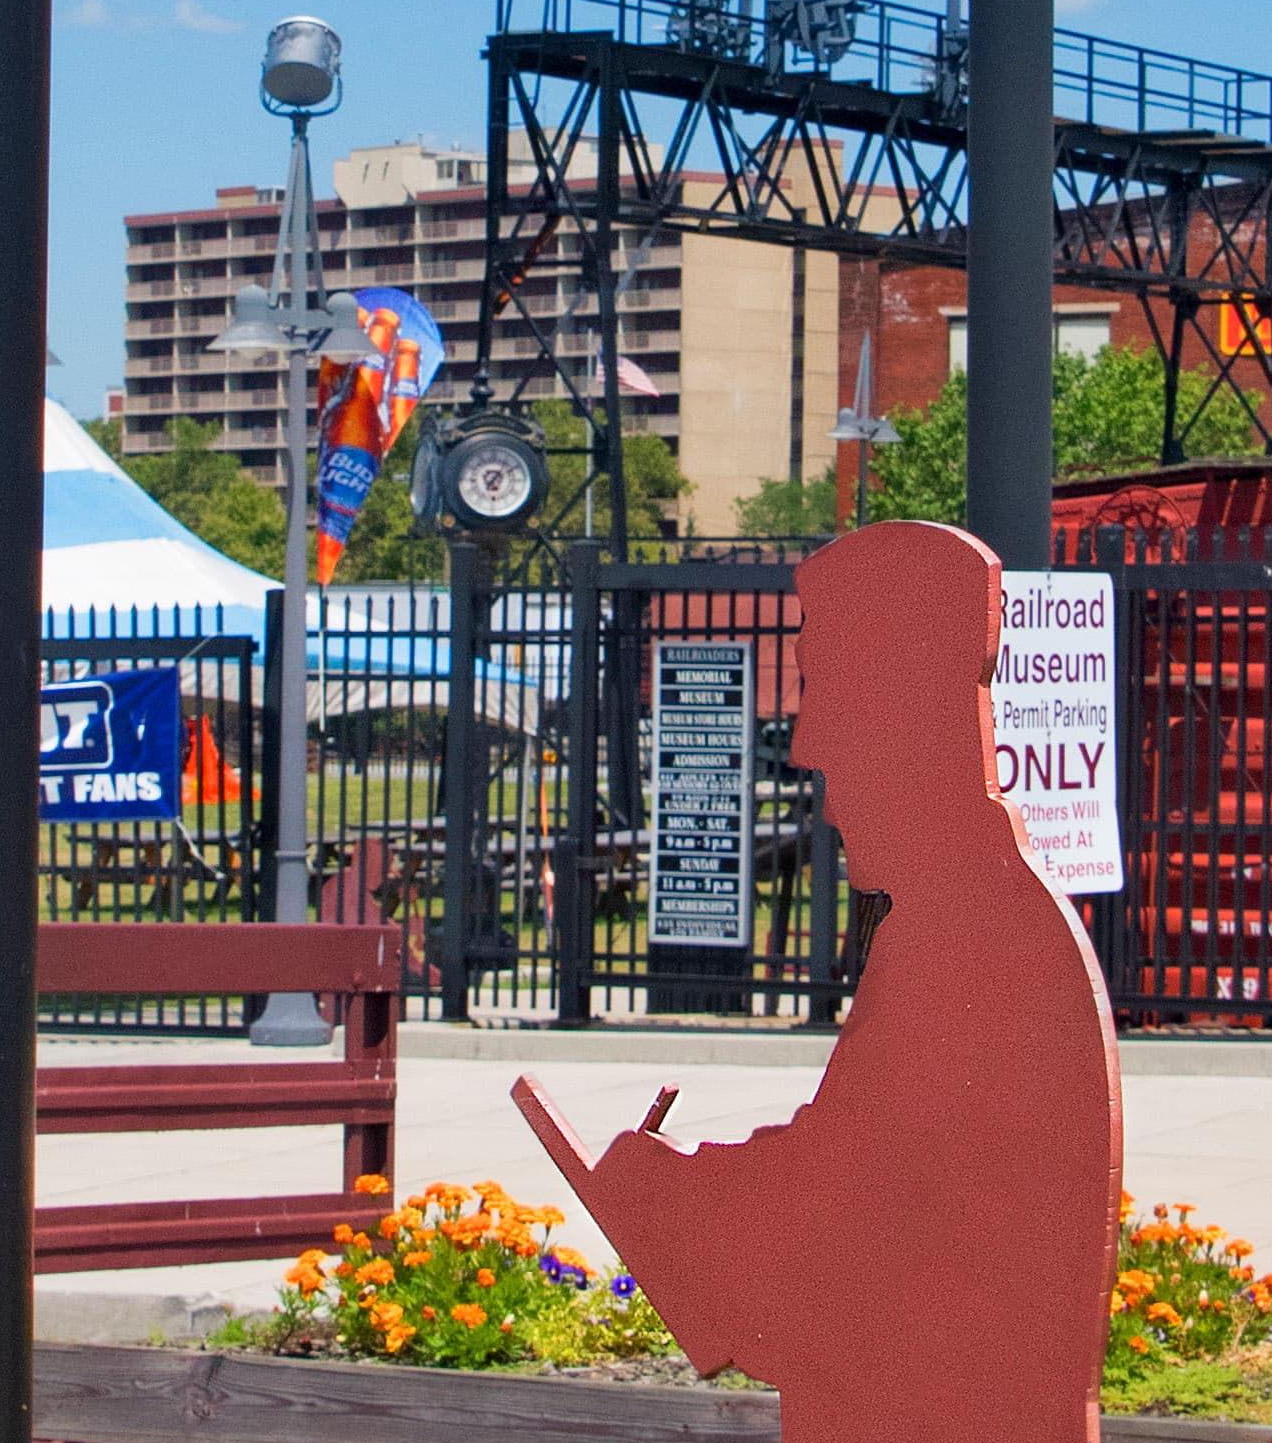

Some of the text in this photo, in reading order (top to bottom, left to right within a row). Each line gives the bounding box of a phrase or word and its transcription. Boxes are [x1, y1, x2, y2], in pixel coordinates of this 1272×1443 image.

[329, 452, 374, 482] BUD
[666, 648, 740, 663] RAILROADERS
[994, 644, 1106, 685] Museum
[675, 670, 733, 684] MEMORIAL
[679, 691, 725, 705] MUSEUM
[1003, 700, 1050, 729] Permit
[1053, 699, 1107, 733] Parking
[661, 733, 742, 747] MUSEUM HOURS
[672, 754, 731, 767] ADMISSION
[997, 742, 1106, 792] ONLY
[73, 772, 162, 804] FANS
[1019, 800, 1101, 824] Others Will
[1076, 829, 1093, 848] At
[679, 858, 721, 871] SUNDAY
[1045, 857, 1115, 882] Expense
